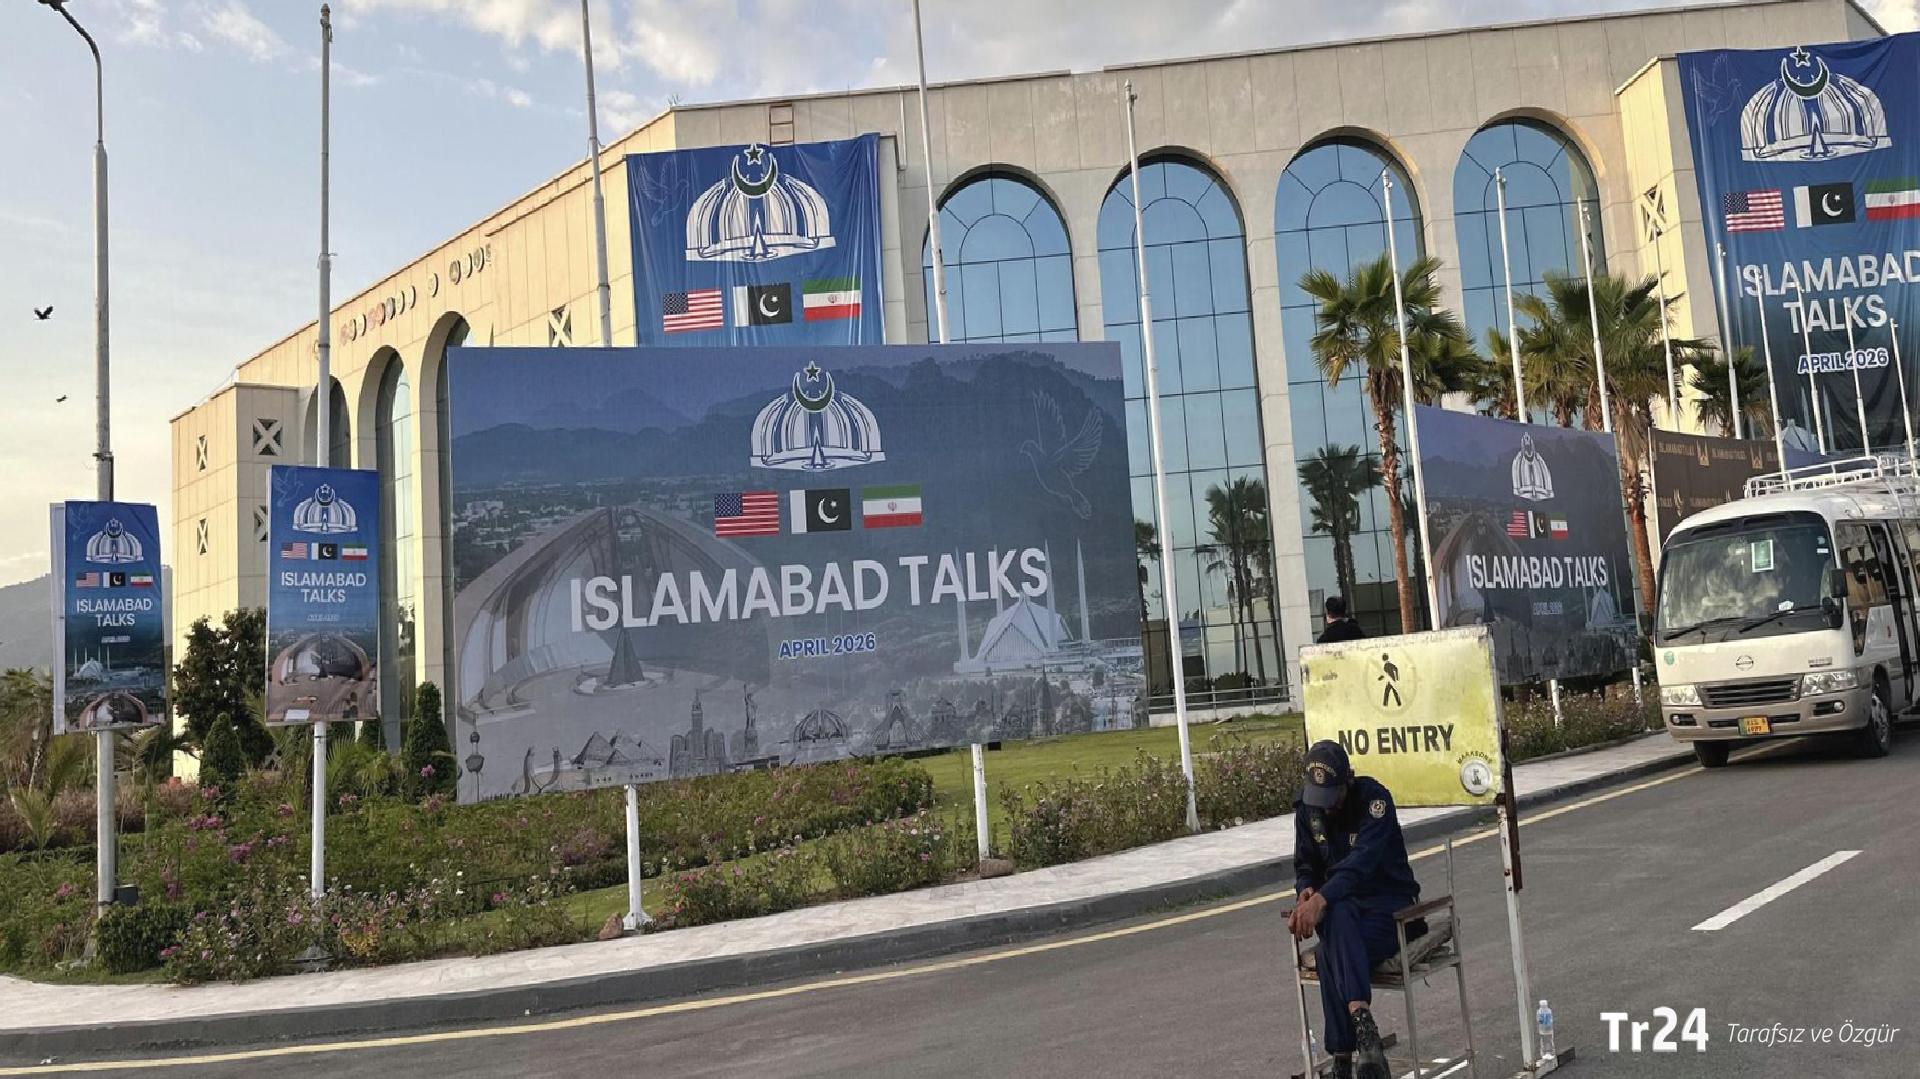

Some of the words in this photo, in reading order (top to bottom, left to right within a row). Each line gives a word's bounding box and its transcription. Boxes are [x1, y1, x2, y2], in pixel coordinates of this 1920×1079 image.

[1736, 251, 1920, 298] ISLAMABAD
[1783, 294, 1887, 334] TALKS
[1798, 353, 1844, 374] APRIL
[1845, 348, 1889, 370] 2026
[281, 572, 366, 586] ISLAMABAD
[1466, 554, 1563, 589] ISLAMABAD
[1563, 555, 1607, 588] TALKS
[301, 588, 346, 603] TALKS
[570, 559, 889, 632] ISLAMABAD
[901, 548, 1048, 605] TALKS
[76, 598, 152, 613] ISLAMABAD
[95, 613, 136, 627] TALKS
[778, 638, 829, 660] APRIL
[832, 632, 876, 655] 2026
[1338, 729, 1369, 755] NO
[1377, 723, 1454, 754] ENTRY
